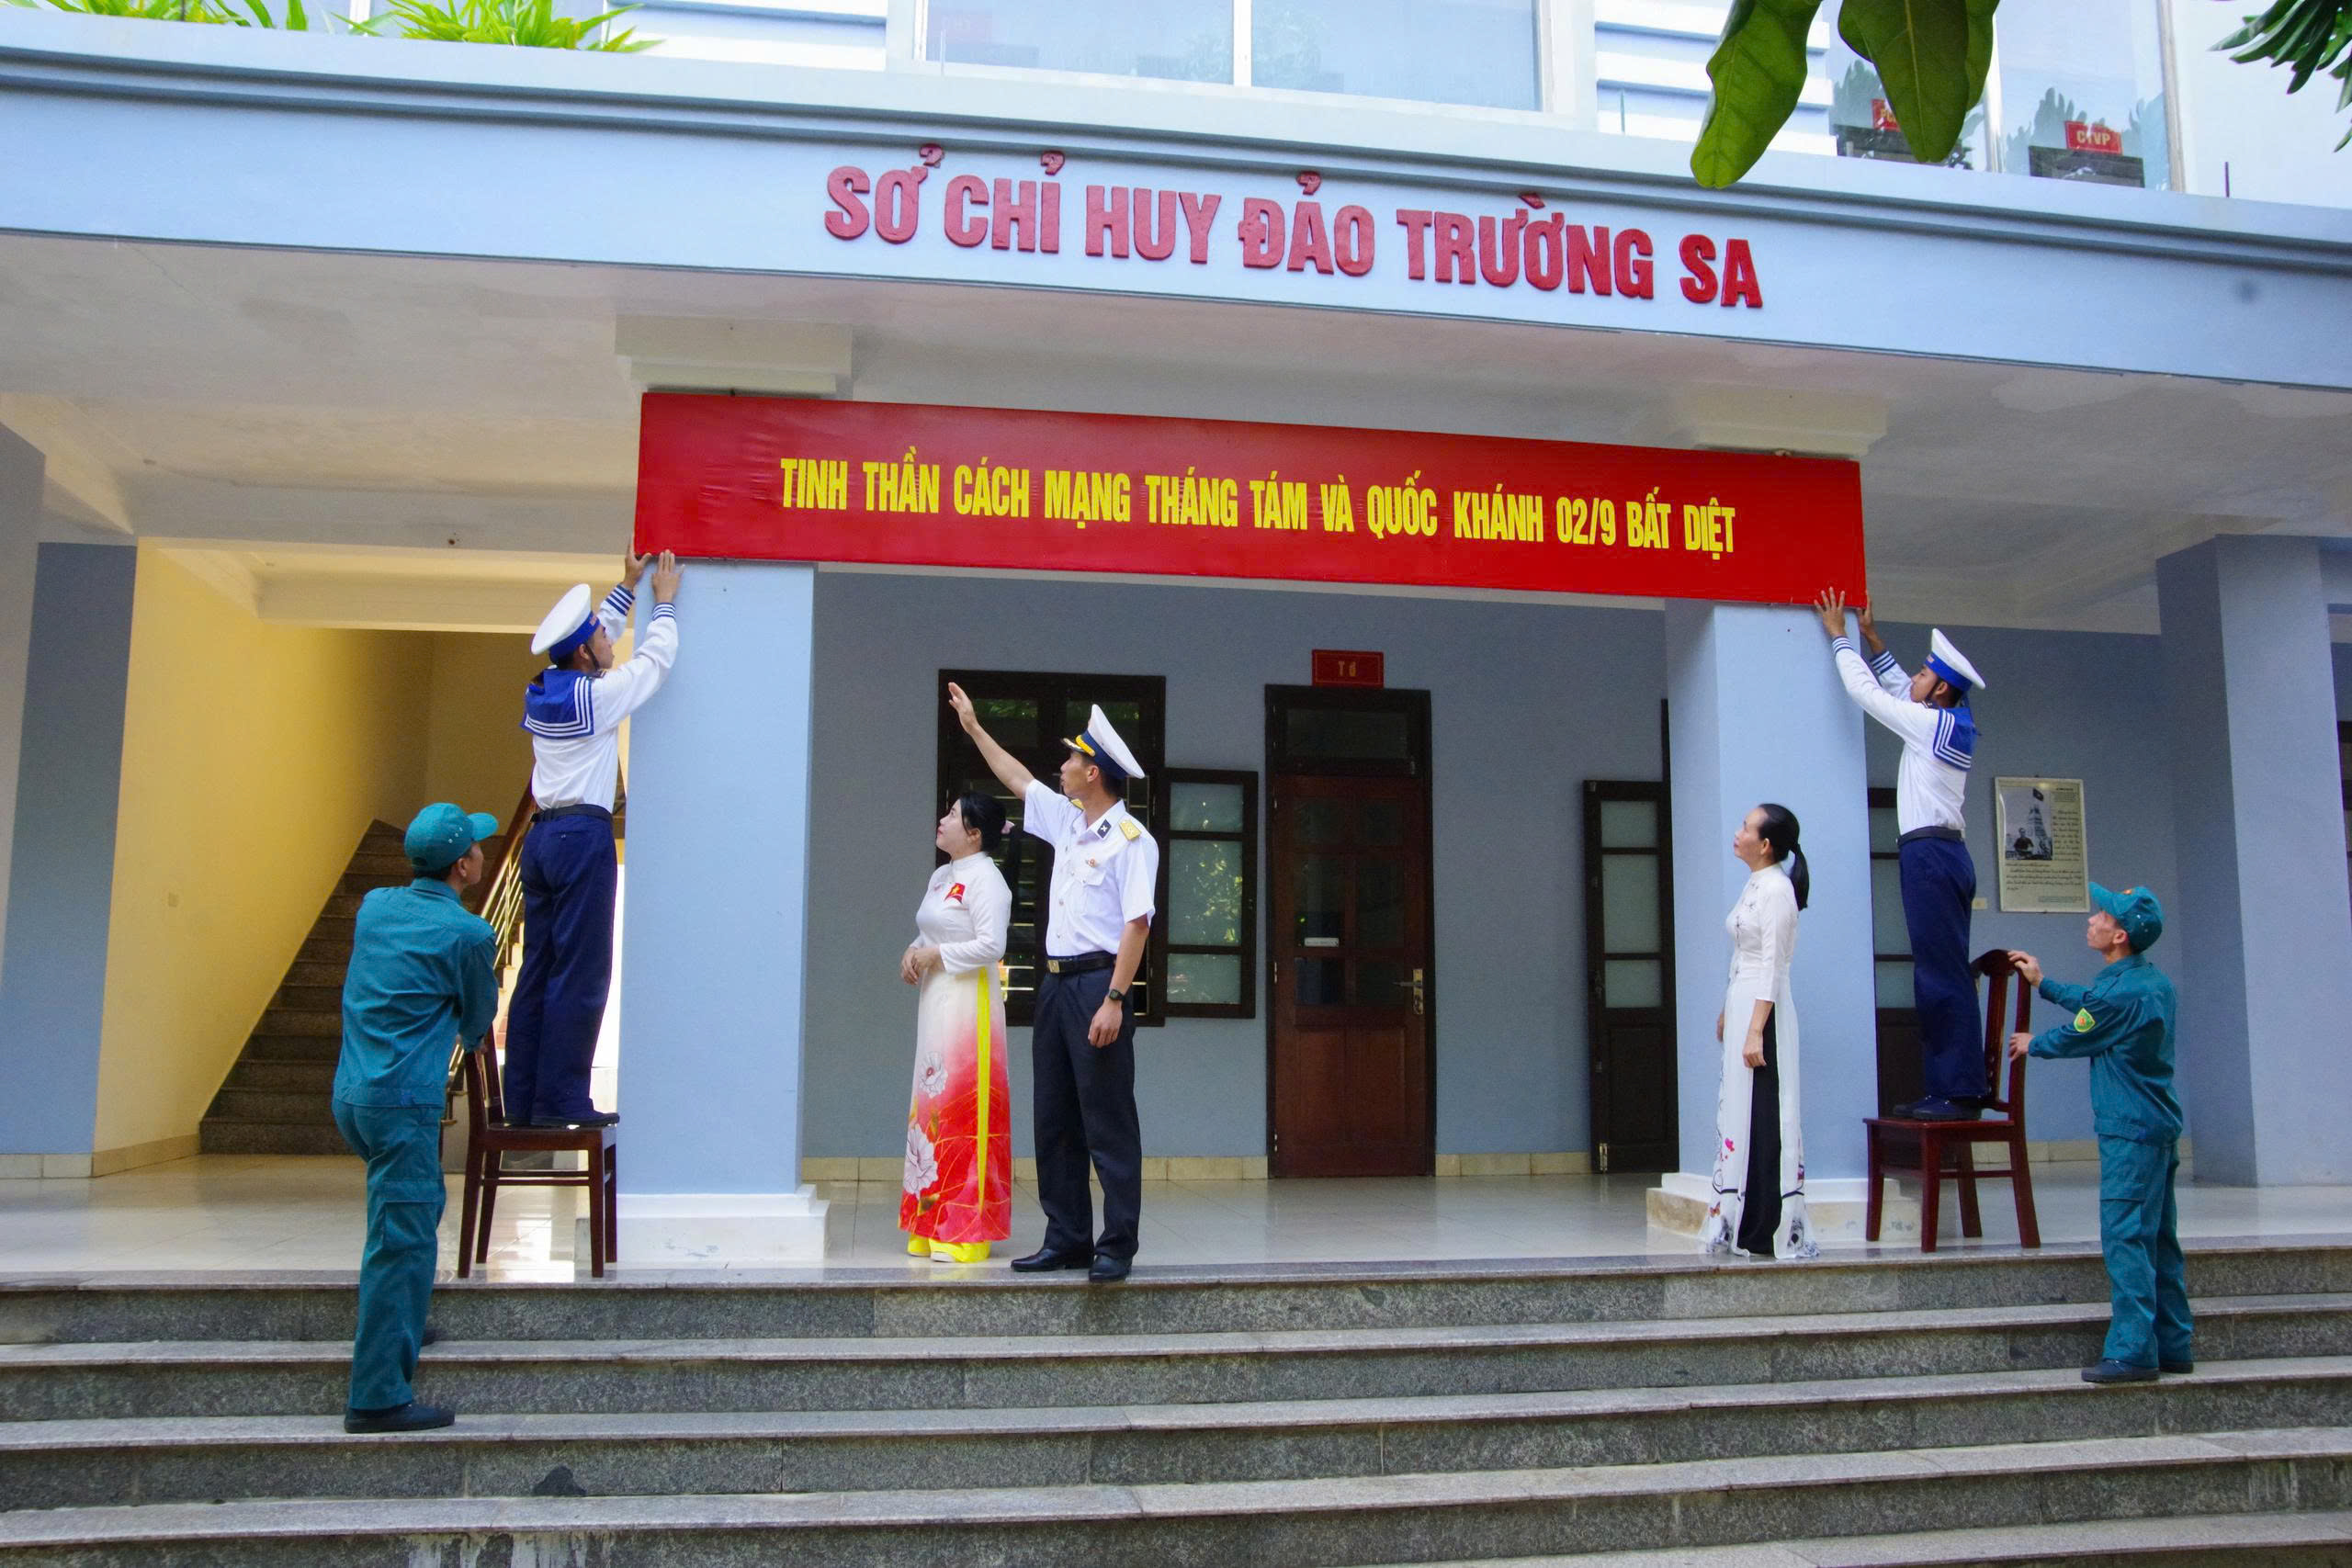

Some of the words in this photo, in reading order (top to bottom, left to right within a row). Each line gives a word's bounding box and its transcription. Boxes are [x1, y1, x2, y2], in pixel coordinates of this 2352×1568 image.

[825, 143, 945, 244] SỞ
[944, 151, 1066, 254] CHỈ
[1086, 185, 1222, 264] HUY
[1238, 171, 1374, 276] ĐẢO
[1396, 191, 1655, 299] TRƯỜNG
[1679, 234, 1763, 308] SA
[781, 458, 848, 510] TINH
[863, 446, 940, 513] THẦN
[954, 457, 1030, 518] CÁCH
[1044, 469, 1131, 529] MẠNG
[1145, 467, 1238, 527] THÁNG
[1249, 470, 1308, 530] TÁM
[1319, 474, 1355, 532] VÀ
[1367, 469, 1438, 539] QUỐC
[1453, 483, 1544, 542] KHÁNH
[1556, 497, 1616, 546] 02/9
[1626, 486, 1671, 548] BẤT
[1683, 497, 1736, 560] DIỆT
